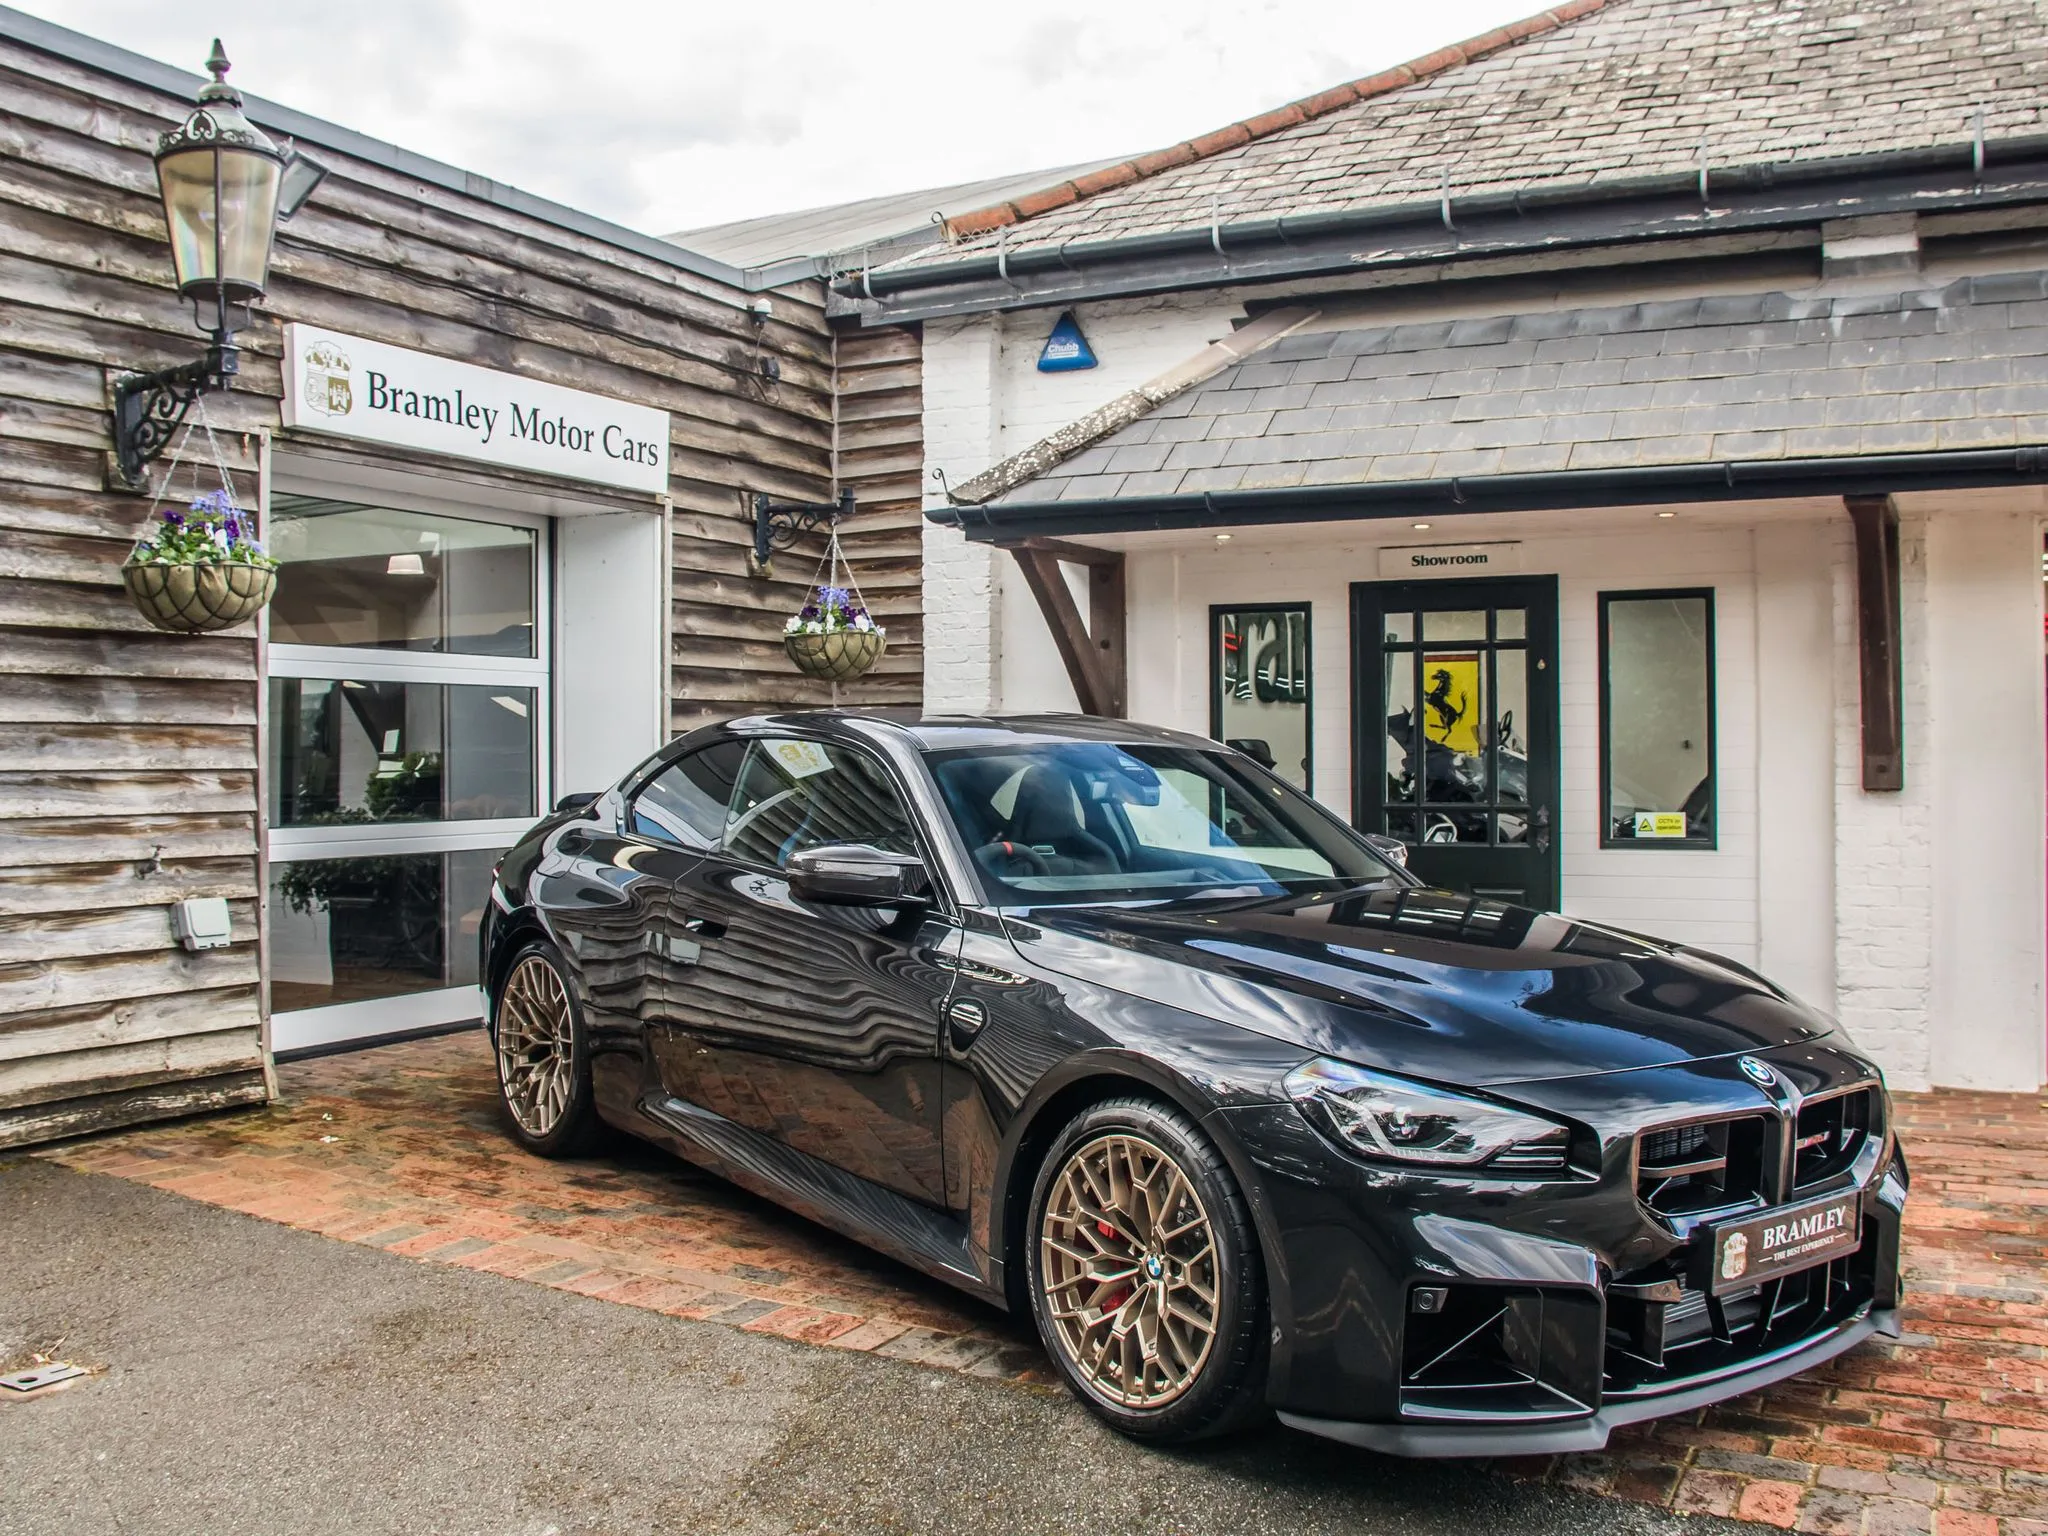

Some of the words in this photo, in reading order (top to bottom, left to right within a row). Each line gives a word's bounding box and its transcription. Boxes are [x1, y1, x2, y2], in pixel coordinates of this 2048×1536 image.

[1048, 342, 1080, 353] Chubb
[365, 369, 498, 444] Bramley
[510, 402, 595, 453] Motor
[602, 424, 659, 467] Cars
[1411, 554, 1488, 567] Showroom
[1762, 1205, 1847, 1250] BRAMLEY
[1773, 1250, 1786, 1262] THE
[1786, 1245, 1802, 1257] BEST
[1801, 1234, 1835, 1252] EXPERIENCE
